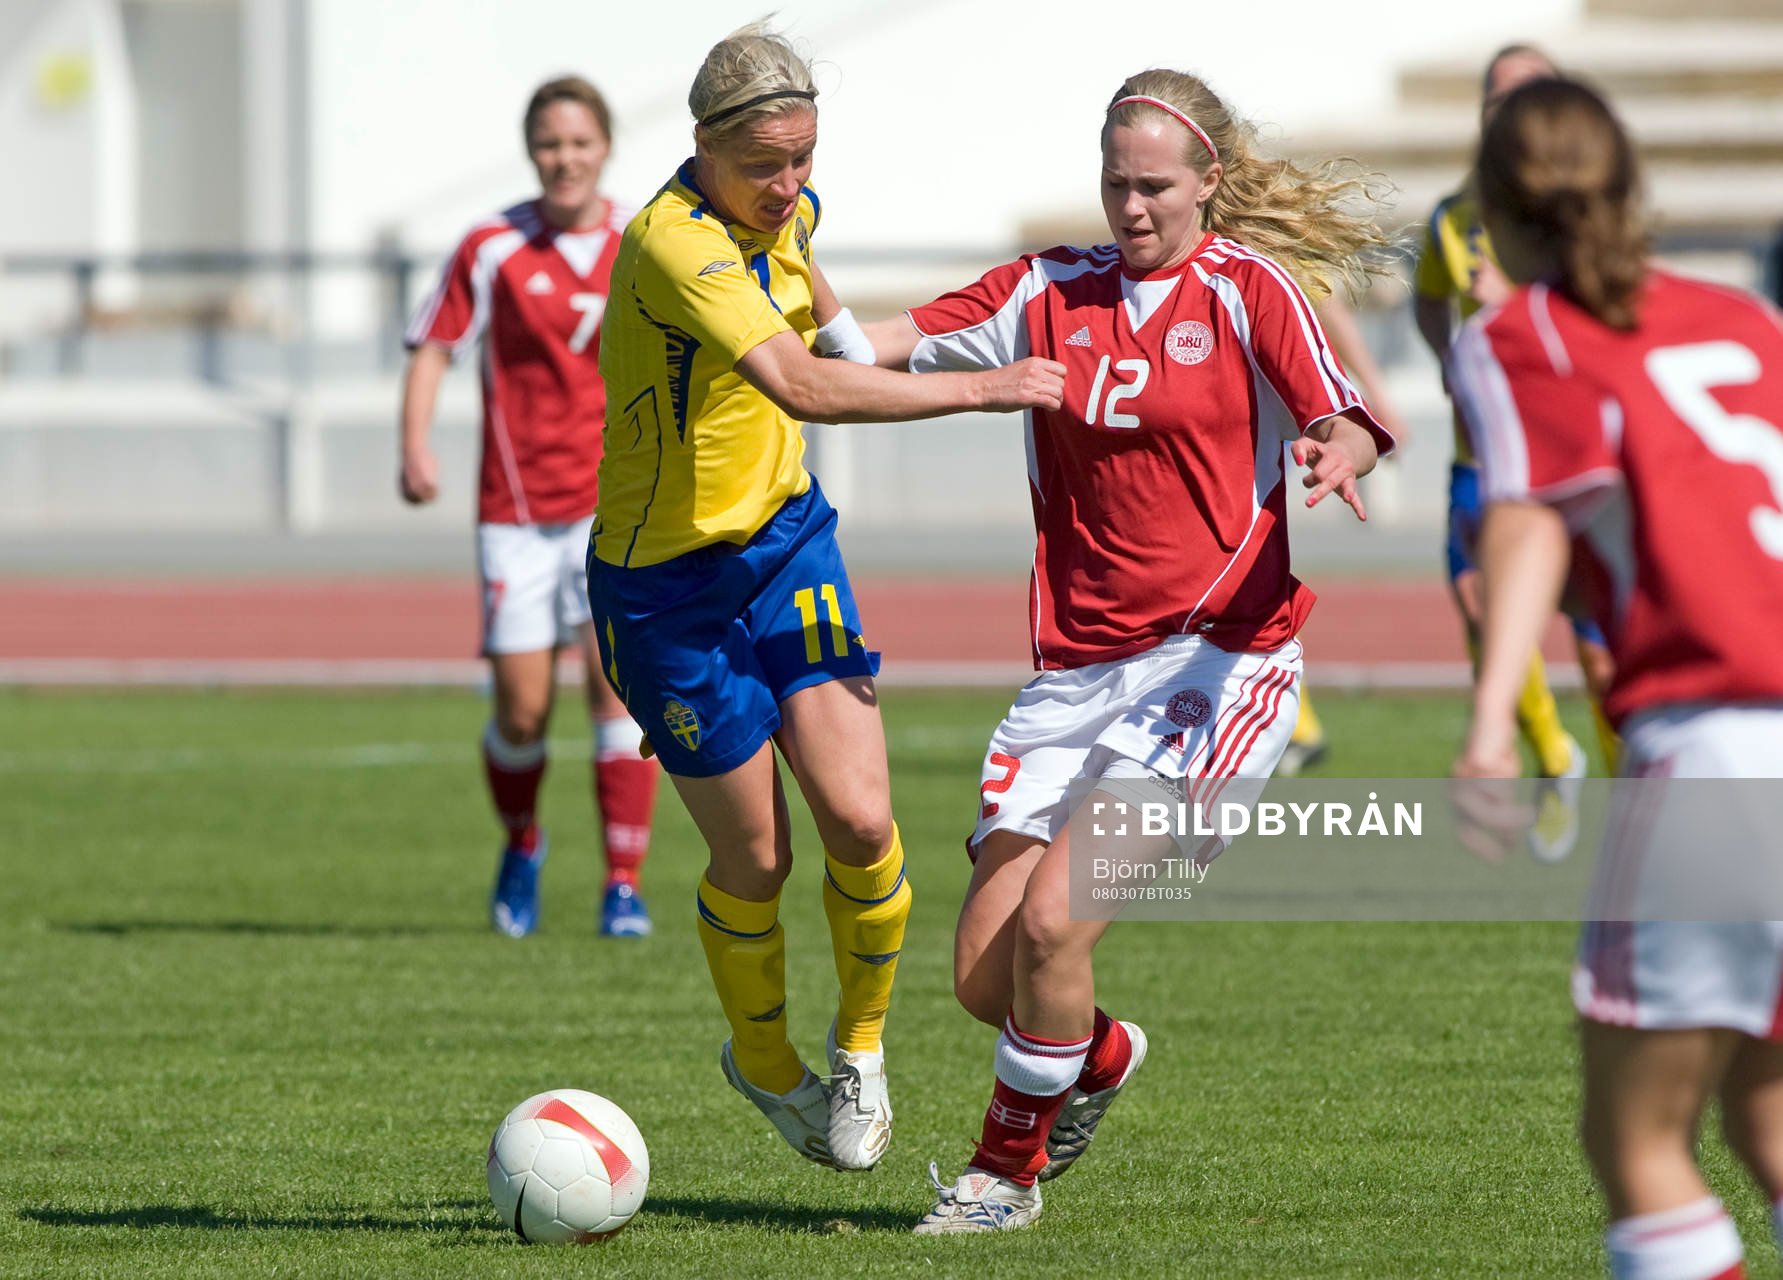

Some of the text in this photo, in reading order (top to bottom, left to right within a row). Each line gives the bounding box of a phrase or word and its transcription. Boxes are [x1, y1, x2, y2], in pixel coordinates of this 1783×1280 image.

[568, 292, 607, 355] 7
[1177, 336, 1202, 348] DBU
[1086, 355, 1150, 429] 12
[1643, 339, 1783, 561] 5
[794, 584, 849, 664] 11
[1176, 701, 1202, 717] DBU
